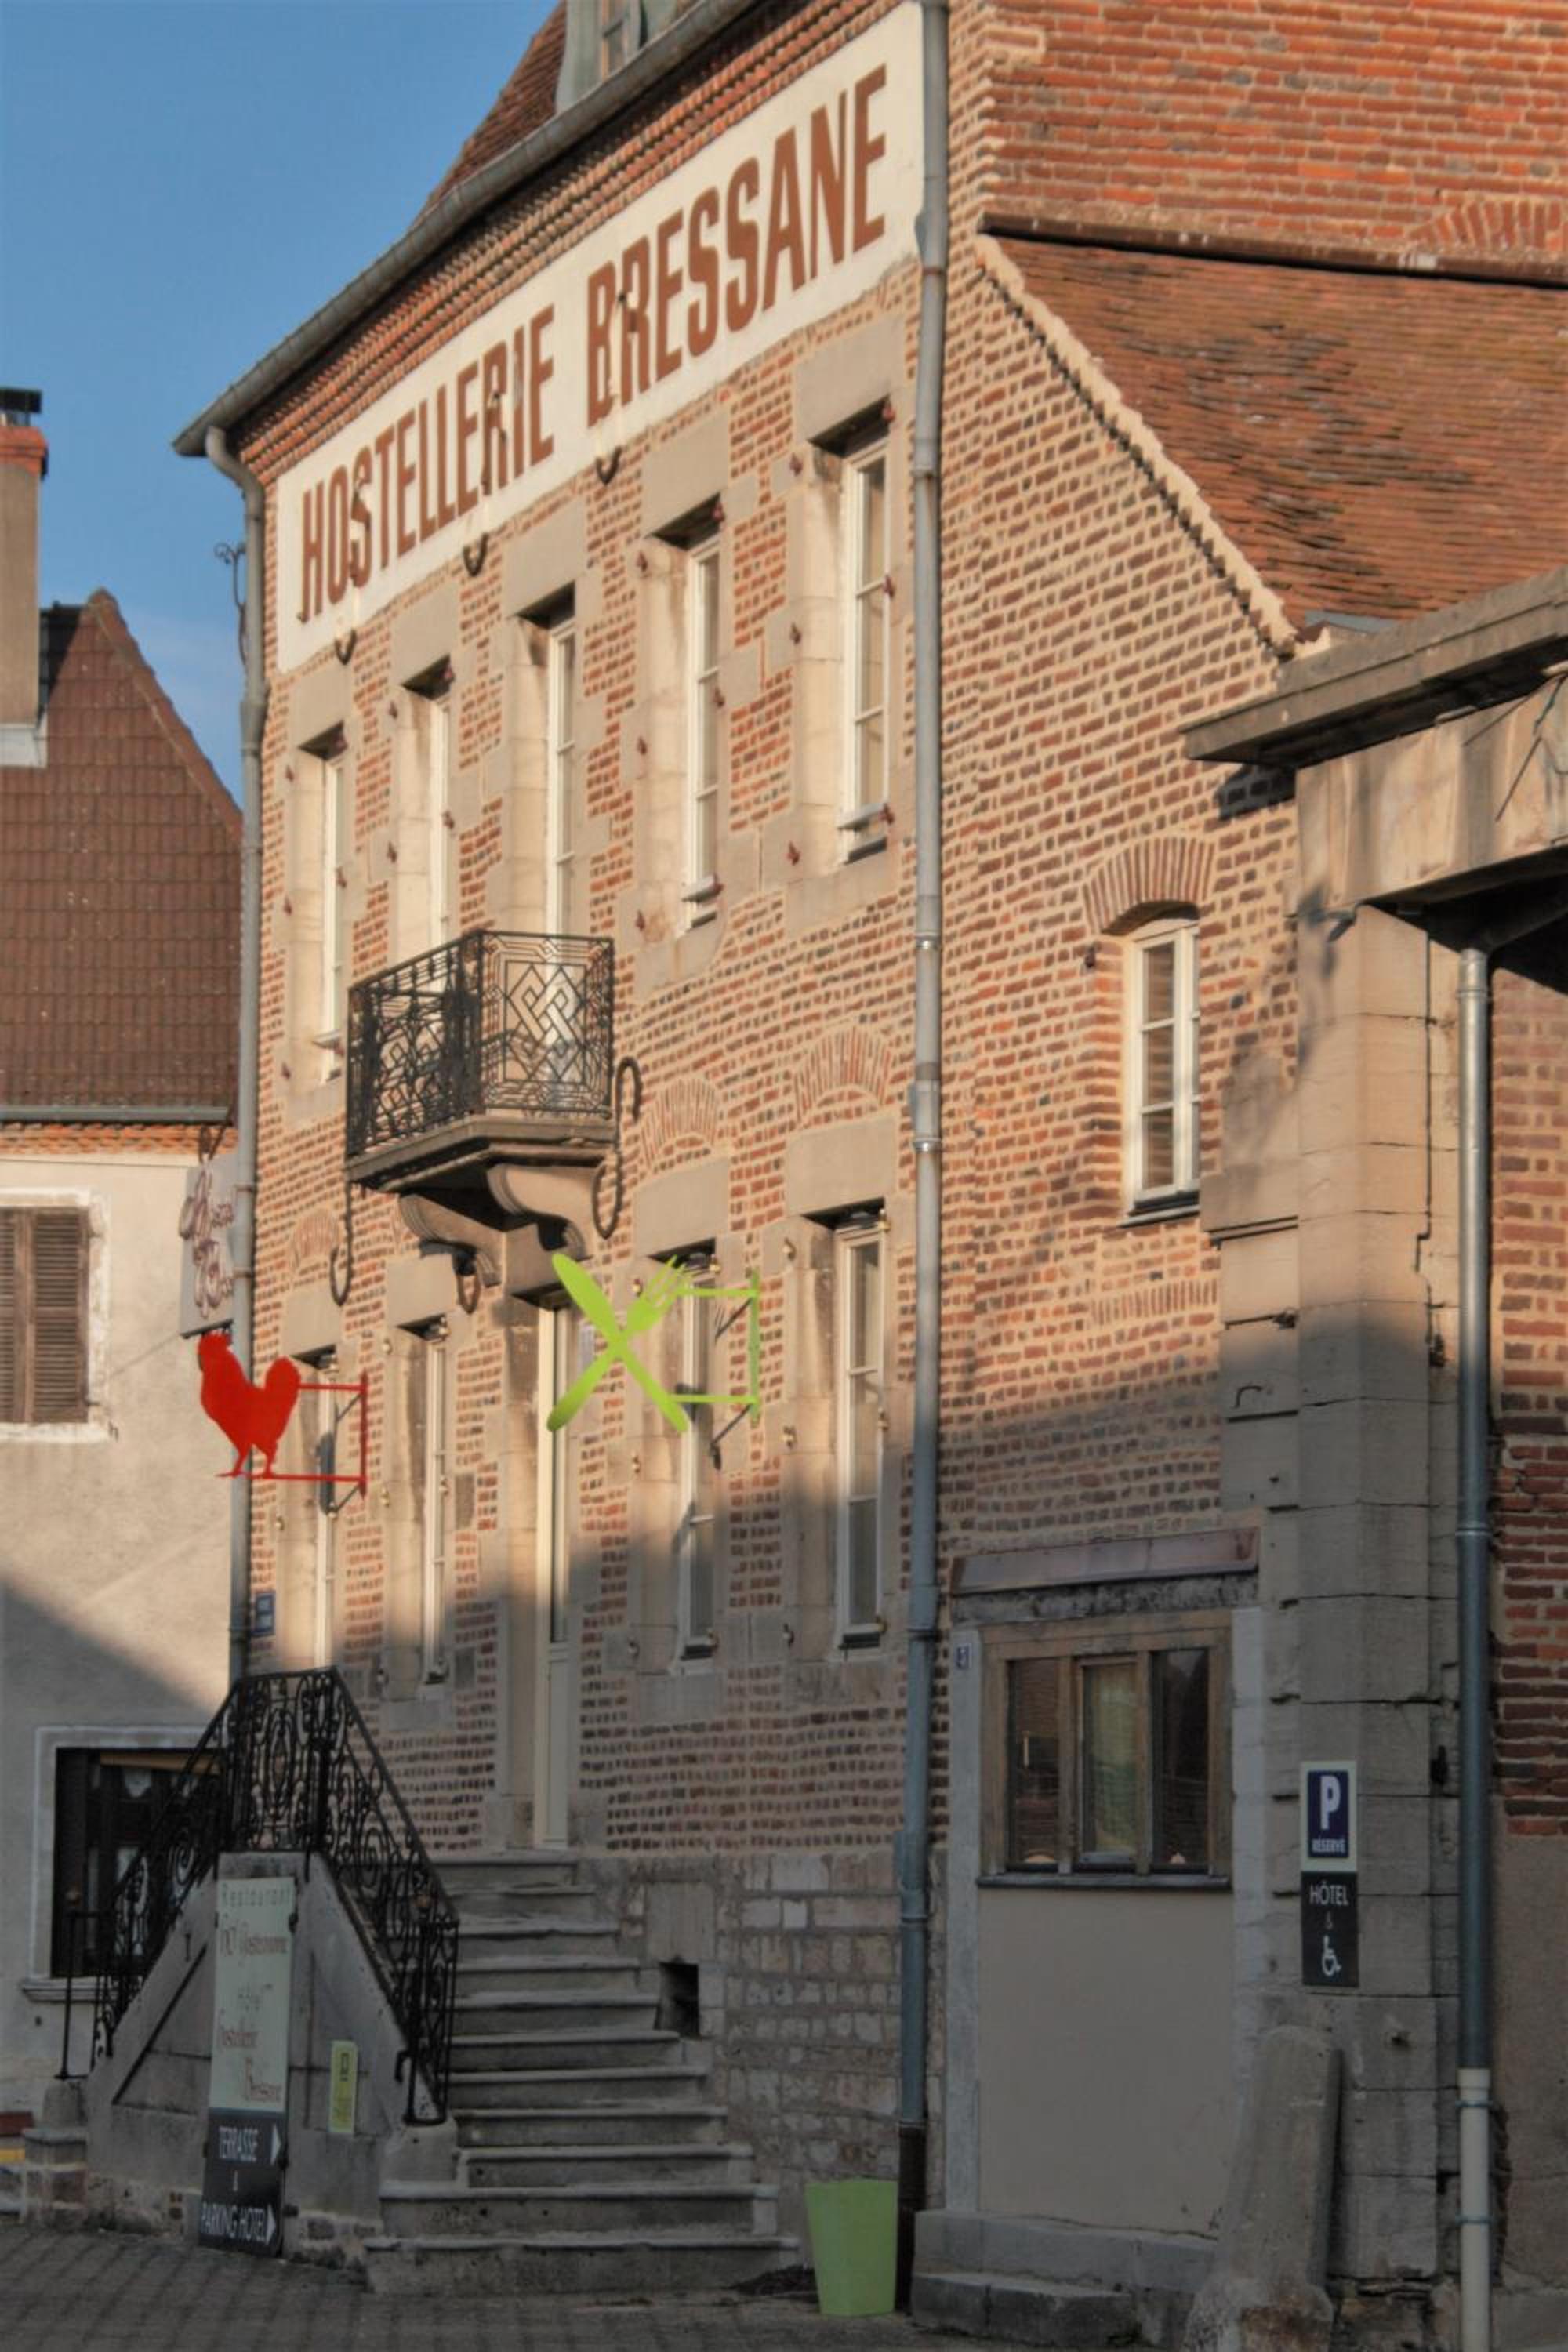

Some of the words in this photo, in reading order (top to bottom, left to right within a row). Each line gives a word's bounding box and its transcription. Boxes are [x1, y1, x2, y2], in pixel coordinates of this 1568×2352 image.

[297, 304, 556, 625] HOSTELLERIE
[586, 63, 887, 429] BRESSANE
[1320, 1774, 1341, 1831] P
[1309, 1880, 1349, 1907] HÔTEL
[219, 2125, 259, 2161] TERRASSE
